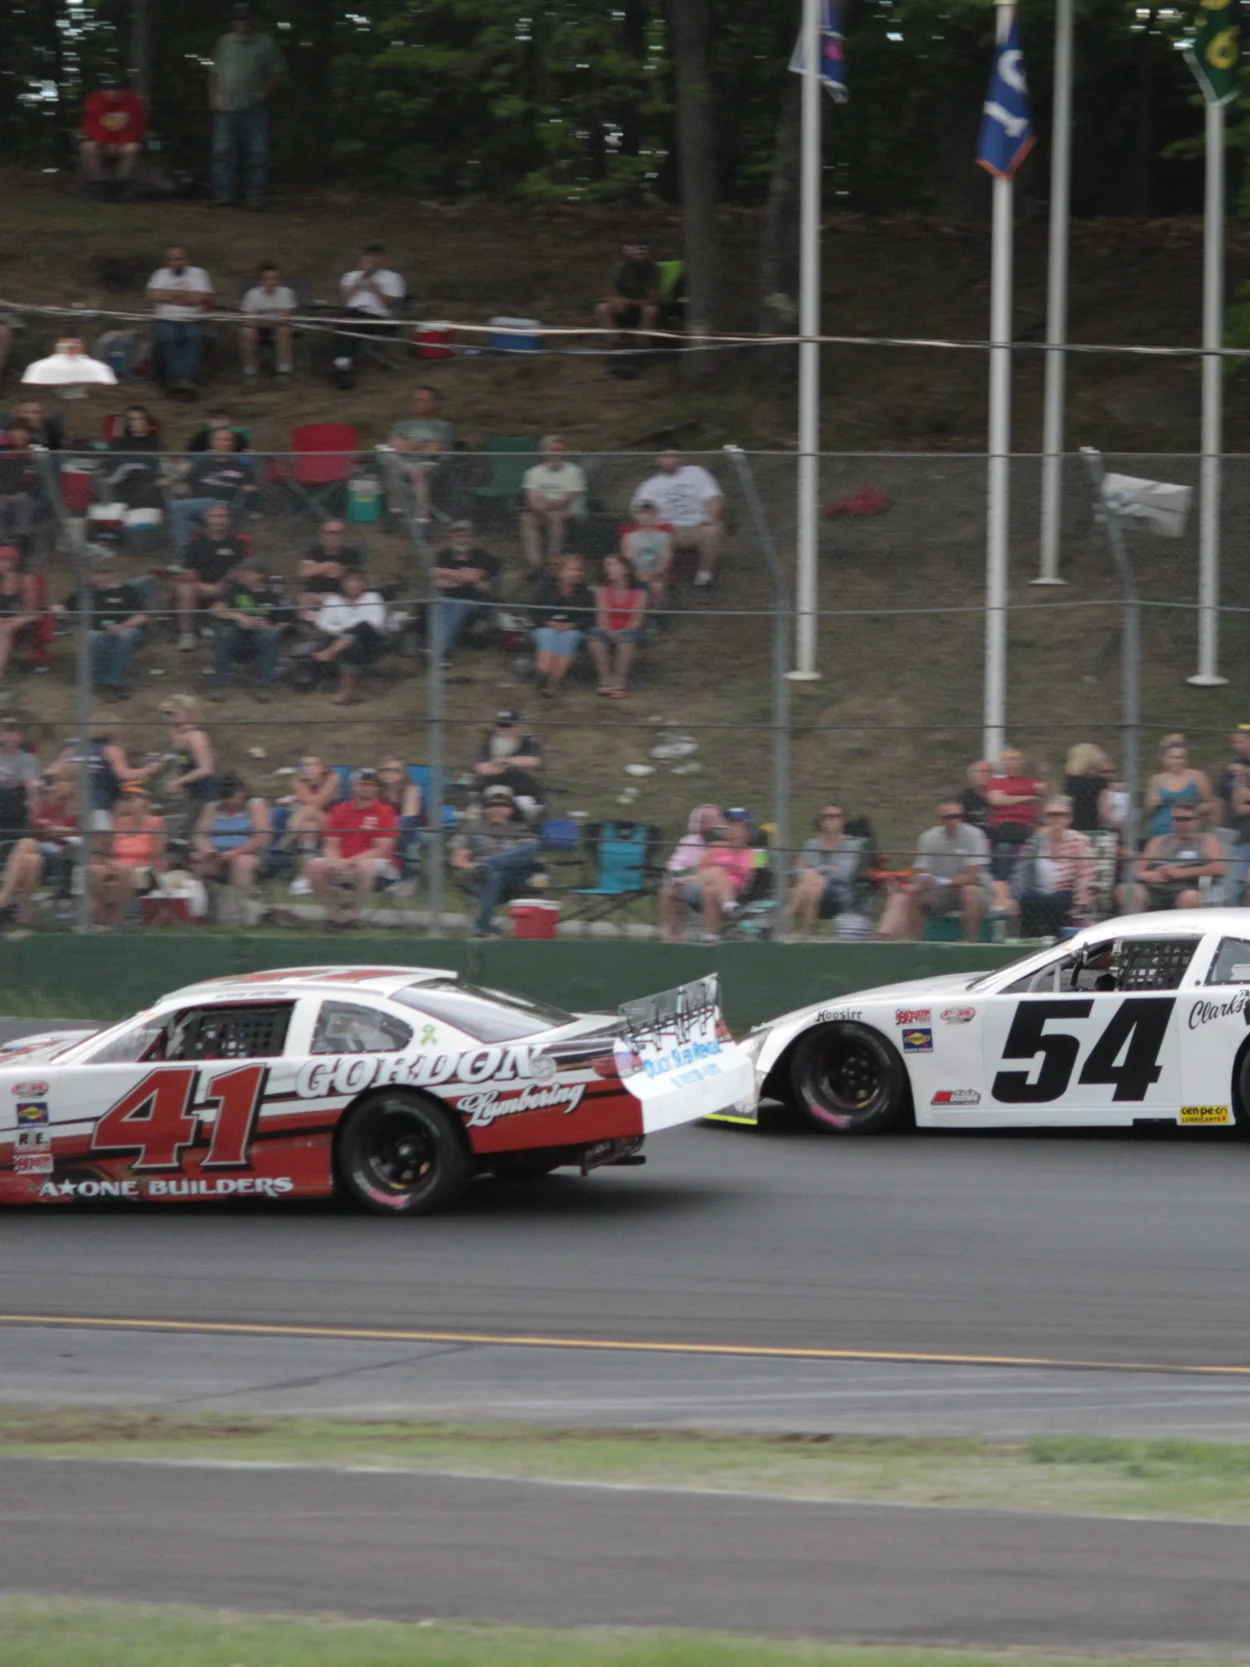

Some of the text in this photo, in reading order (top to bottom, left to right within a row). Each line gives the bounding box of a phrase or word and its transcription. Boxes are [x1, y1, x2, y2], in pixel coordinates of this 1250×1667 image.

[295, 1047, 550, 1099] GORDON
[990, 997, 1178, 1103] 54
[90, 1062, 269, 1169] 41
[456, 1082, 588, 1127] Lumbering
[147, 1176, 295, 1198] BUILDERS
